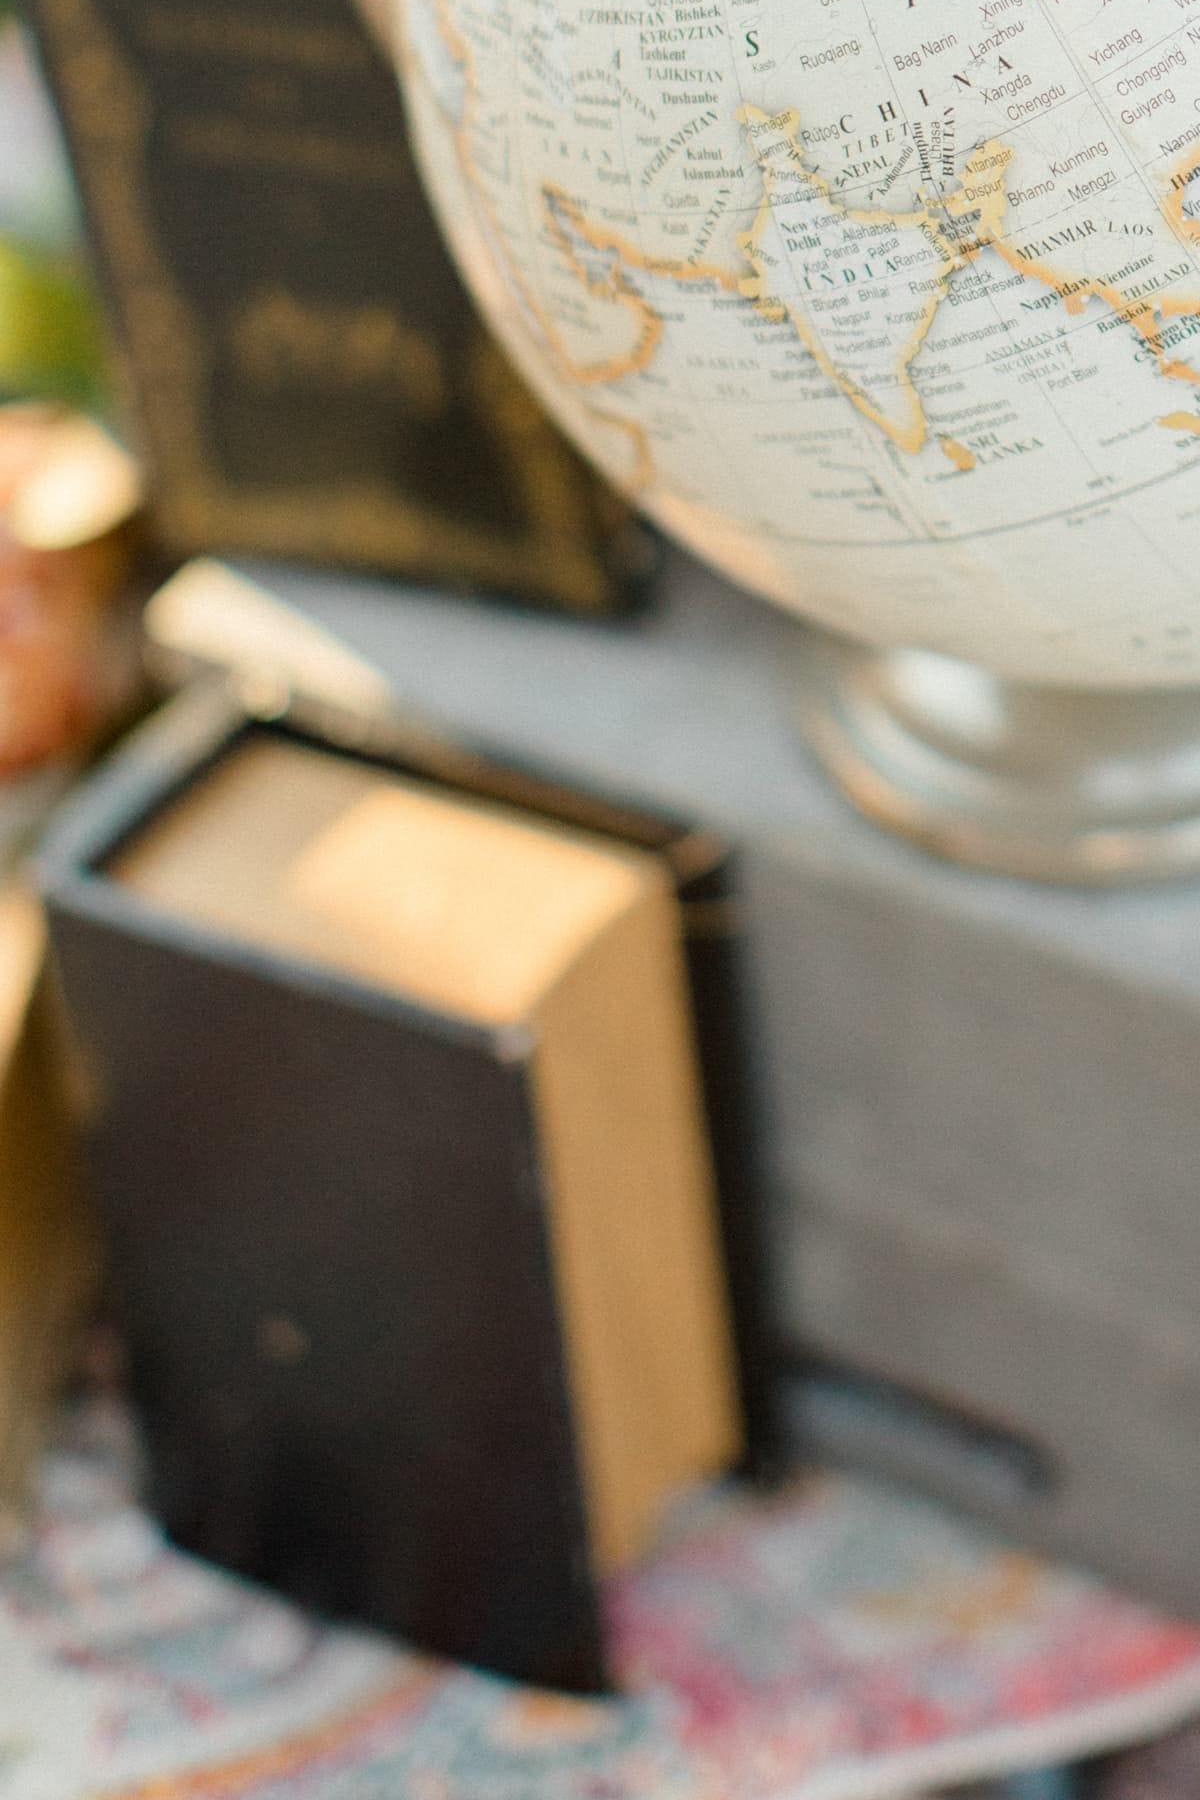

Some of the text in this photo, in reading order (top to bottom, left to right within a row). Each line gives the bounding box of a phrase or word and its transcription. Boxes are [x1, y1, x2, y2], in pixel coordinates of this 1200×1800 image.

[675, 6, 721, 22] Bishkek
[800, 38, 862, 72] Ruoqiang
[894, 33, 958, 72] Bag Narin
[968, 20, 1025, 60] Lanzhou
[1089, 27, 1143, 66] Yichang
[1116, 50, 1187, 97] Chongqing
[1008, 83, 1067, 122] Chengdu
[1120, 87, 1176, 125] Guiyang
[1050, 139, 1109, 178] Kunming
[965, 181, 1002, 202] Dispur
[1008, 179, 1055, 207] Bhamo
[1068, 169, 1117, 201] Mengzi
[1017, 219, 1097, 263] MYANMAR
[1120, 262, 1191, 301] THAILAND
